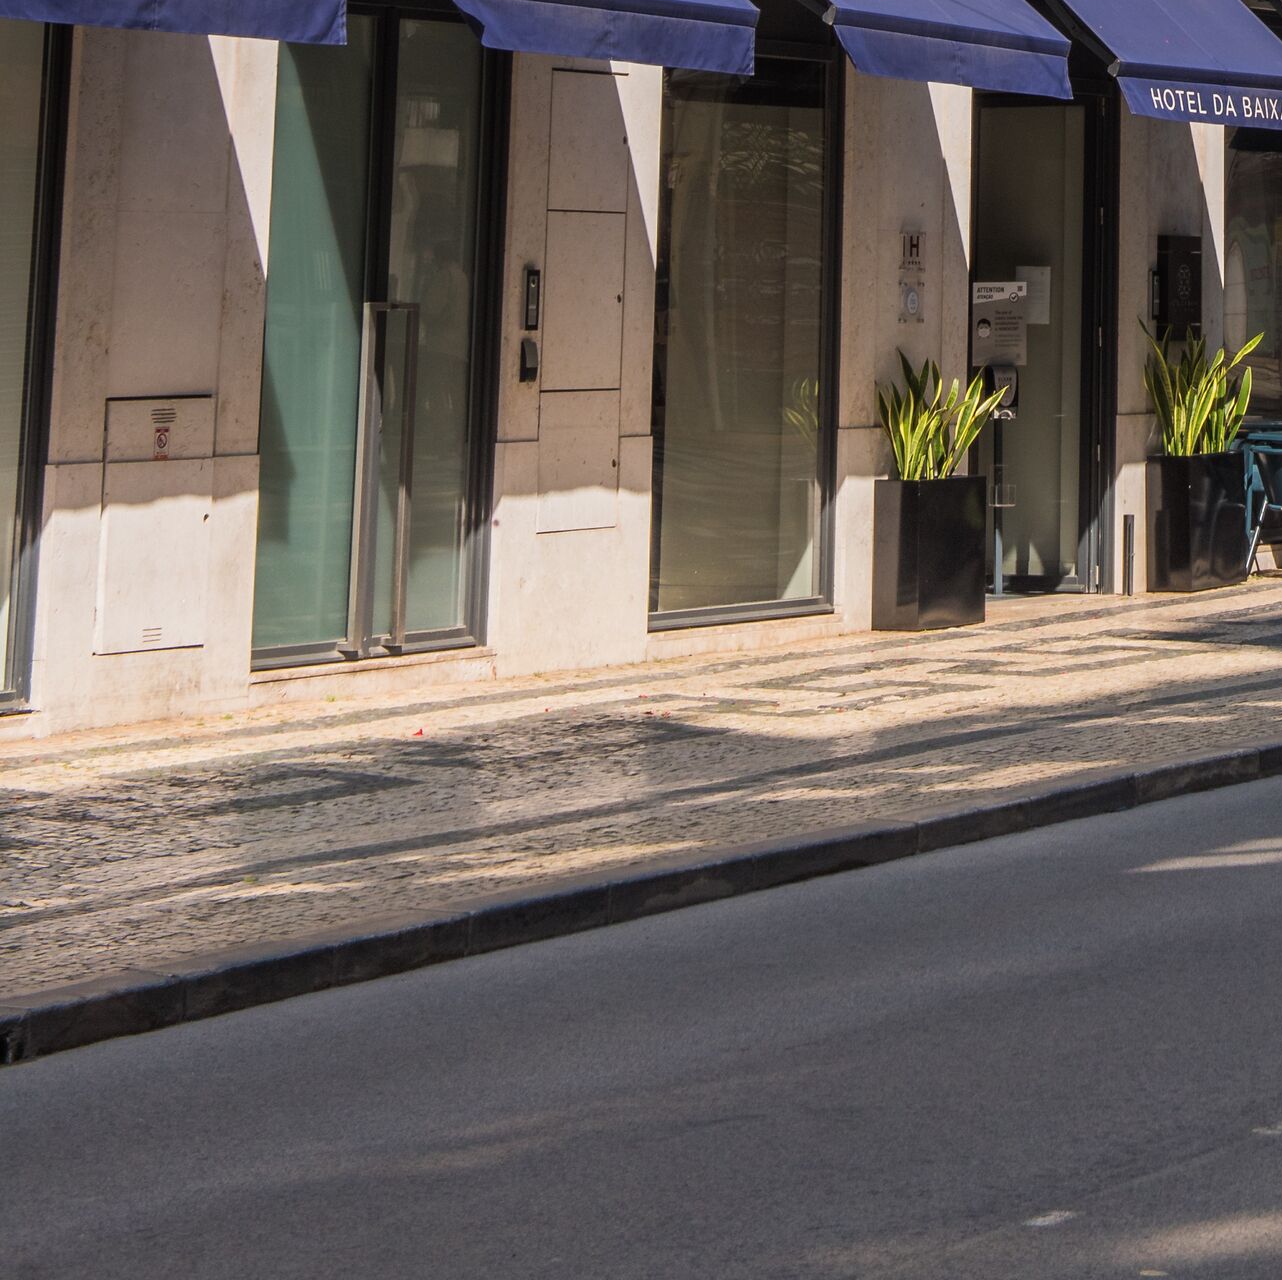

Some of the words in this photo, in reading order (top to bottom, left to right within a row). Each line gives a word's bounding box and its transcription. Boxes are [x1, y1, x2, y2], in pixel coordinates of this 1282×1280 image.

[1150, 87, 1207, 115] HOTEL
[1212, 93, 1237, 117] DA
[976, 286, 1005, 294] ATTENTION
